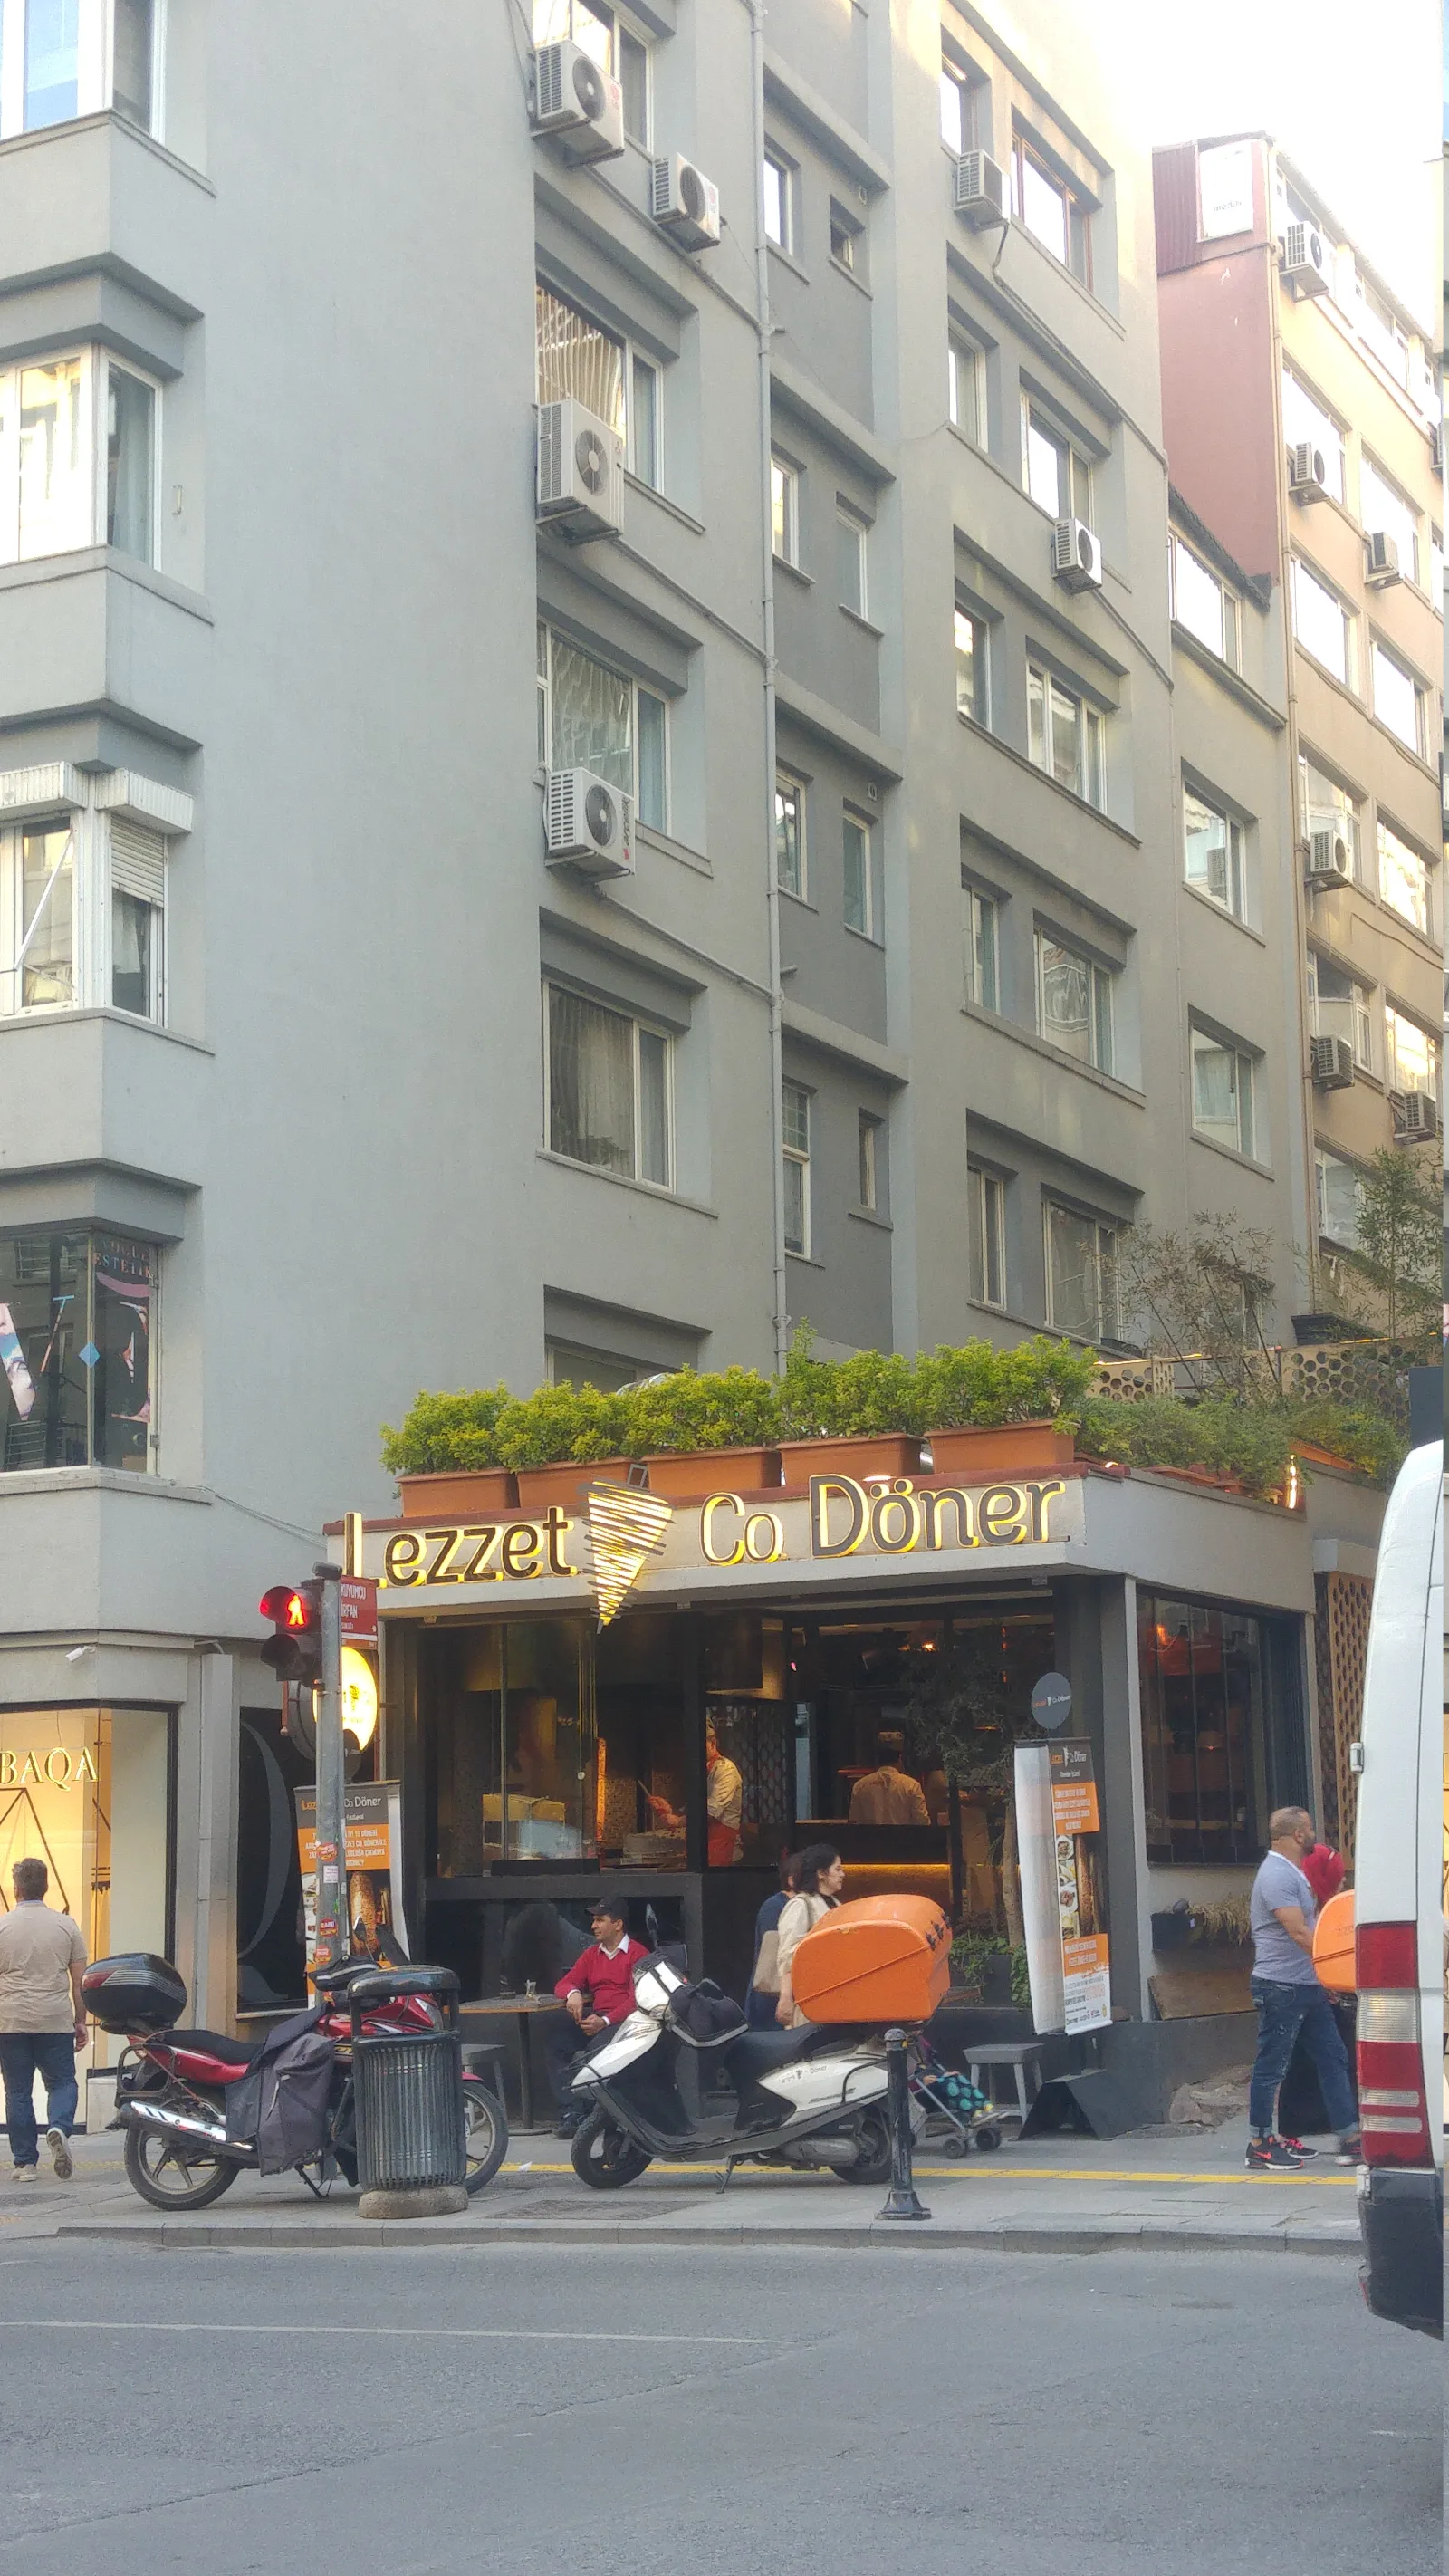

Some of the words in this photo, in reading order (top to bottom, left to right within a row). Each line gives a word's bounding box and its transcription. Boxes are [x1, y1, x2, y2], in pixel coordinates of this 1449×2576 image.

[345, 1505, 575, 1588] Lezzet
[809, 1473, 1066, 1558] Döner
[354, 1795, 381, 1808] Döner
